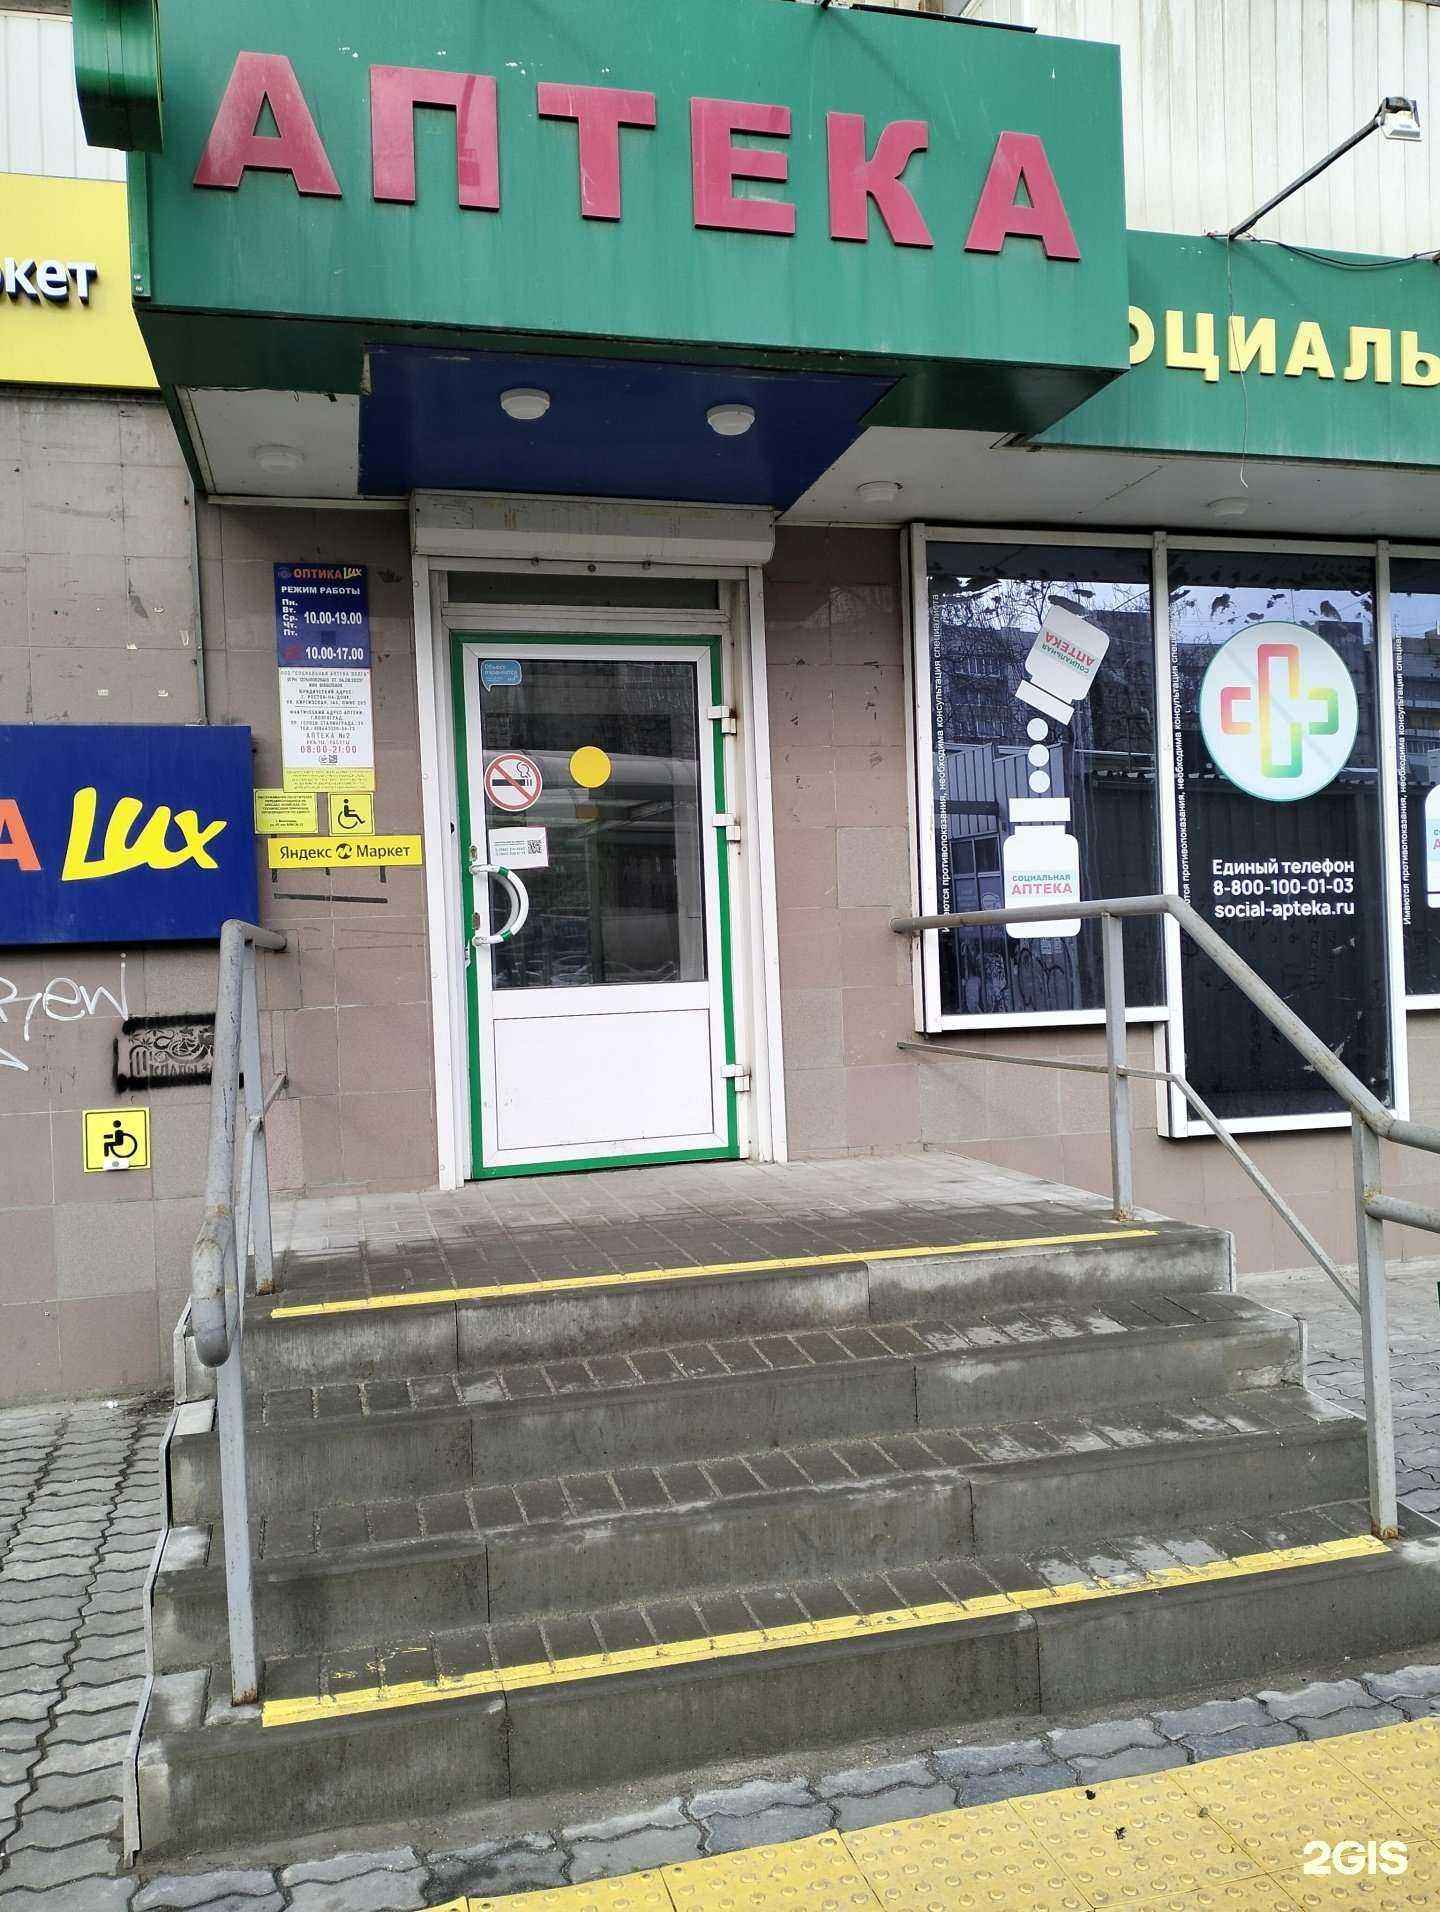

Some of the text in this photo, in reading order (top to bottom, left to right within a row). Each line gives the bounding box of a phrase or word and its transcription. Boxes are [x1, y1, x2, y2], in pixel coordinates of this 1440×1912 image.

[193, 51, 1080, 262] АПТЕКА
[0, 256, 97, 300] кет
[293, 568, 342, 579] ОПТИКА
[281, 586, 361, 595] РЕЖИМ РАБОТЫ
[283, 614, 298, 622] Ср.
[304, 611, 362, 625] 10.00-19.00
[306, 646, 364, 660] 10.00-17.00
[1042, 644, 1090, 674] СОЦИАЛЬНАЯ
[1046, 632, 1095, 666] АПТЕКА
[935, 660, 944, 728] консультация
[1172, 665, 1182, 730] консультация
[1397, 674, 1406, 735] консультация
[938, 731, 947, 791] необходима
[1175, 732, 1184, 789] необходима
[1399, 737, 1408, 793] необходима
[61, 787, 228, 881] Lux
[940, 793, 950, 886] противопоказания,
[280, 844, 410, 860] Яндекс Маркет
[1012, 874, 1071, 882] СОЦИАЛЬНАЯ
[1212, 858, 1355, 877] Единый телефон
[1012, 883, 1073, 895] АПТЕКА
[1213, 878, 1354, 896] 8-800-100-01-03
[1214, 900, 1355, 921] social-apteka.ru
